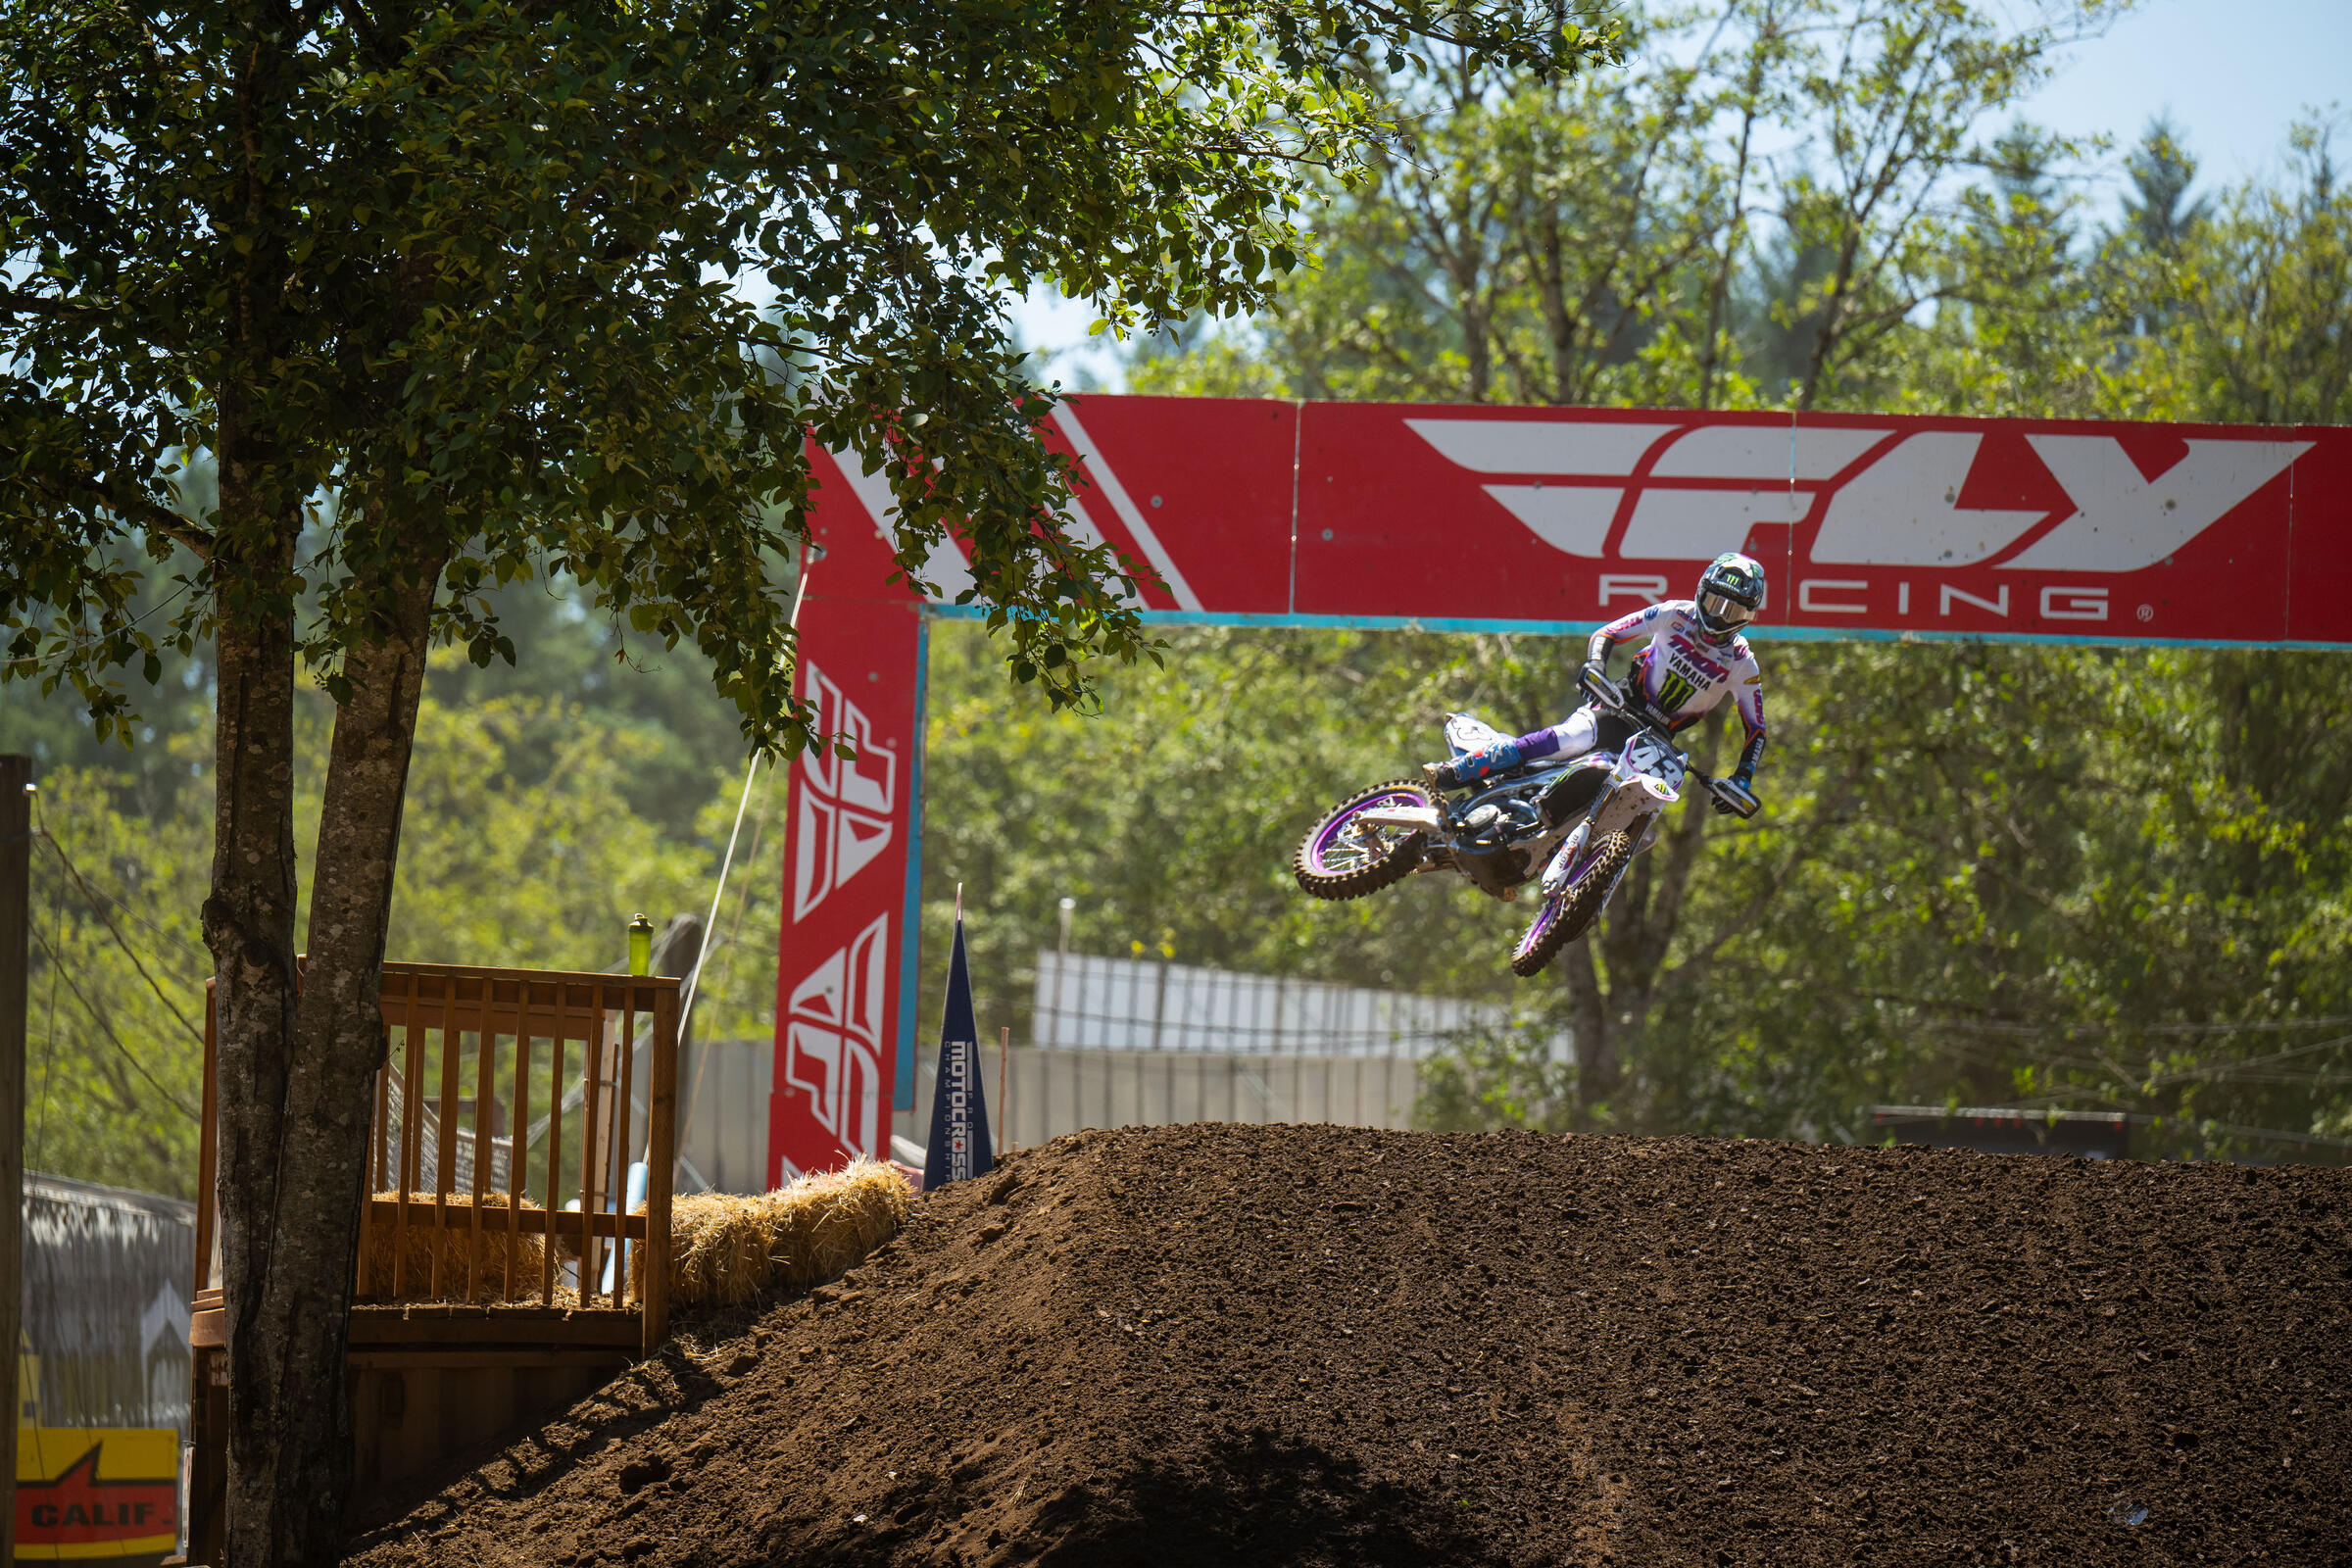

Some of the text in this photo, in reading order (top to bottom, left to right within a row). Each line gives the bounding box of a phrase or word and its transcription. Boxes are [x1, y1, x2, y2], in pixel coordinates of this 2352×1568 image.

[1403, 417, 2318, 573] FLY
[1598, 573, 2109, 620] RCING
[1669, 653, 1711, 691] YAMAHA
[1629, 745, 1683, 785] 43
[951, 1041, 966, 1181] MOTOCROSS
